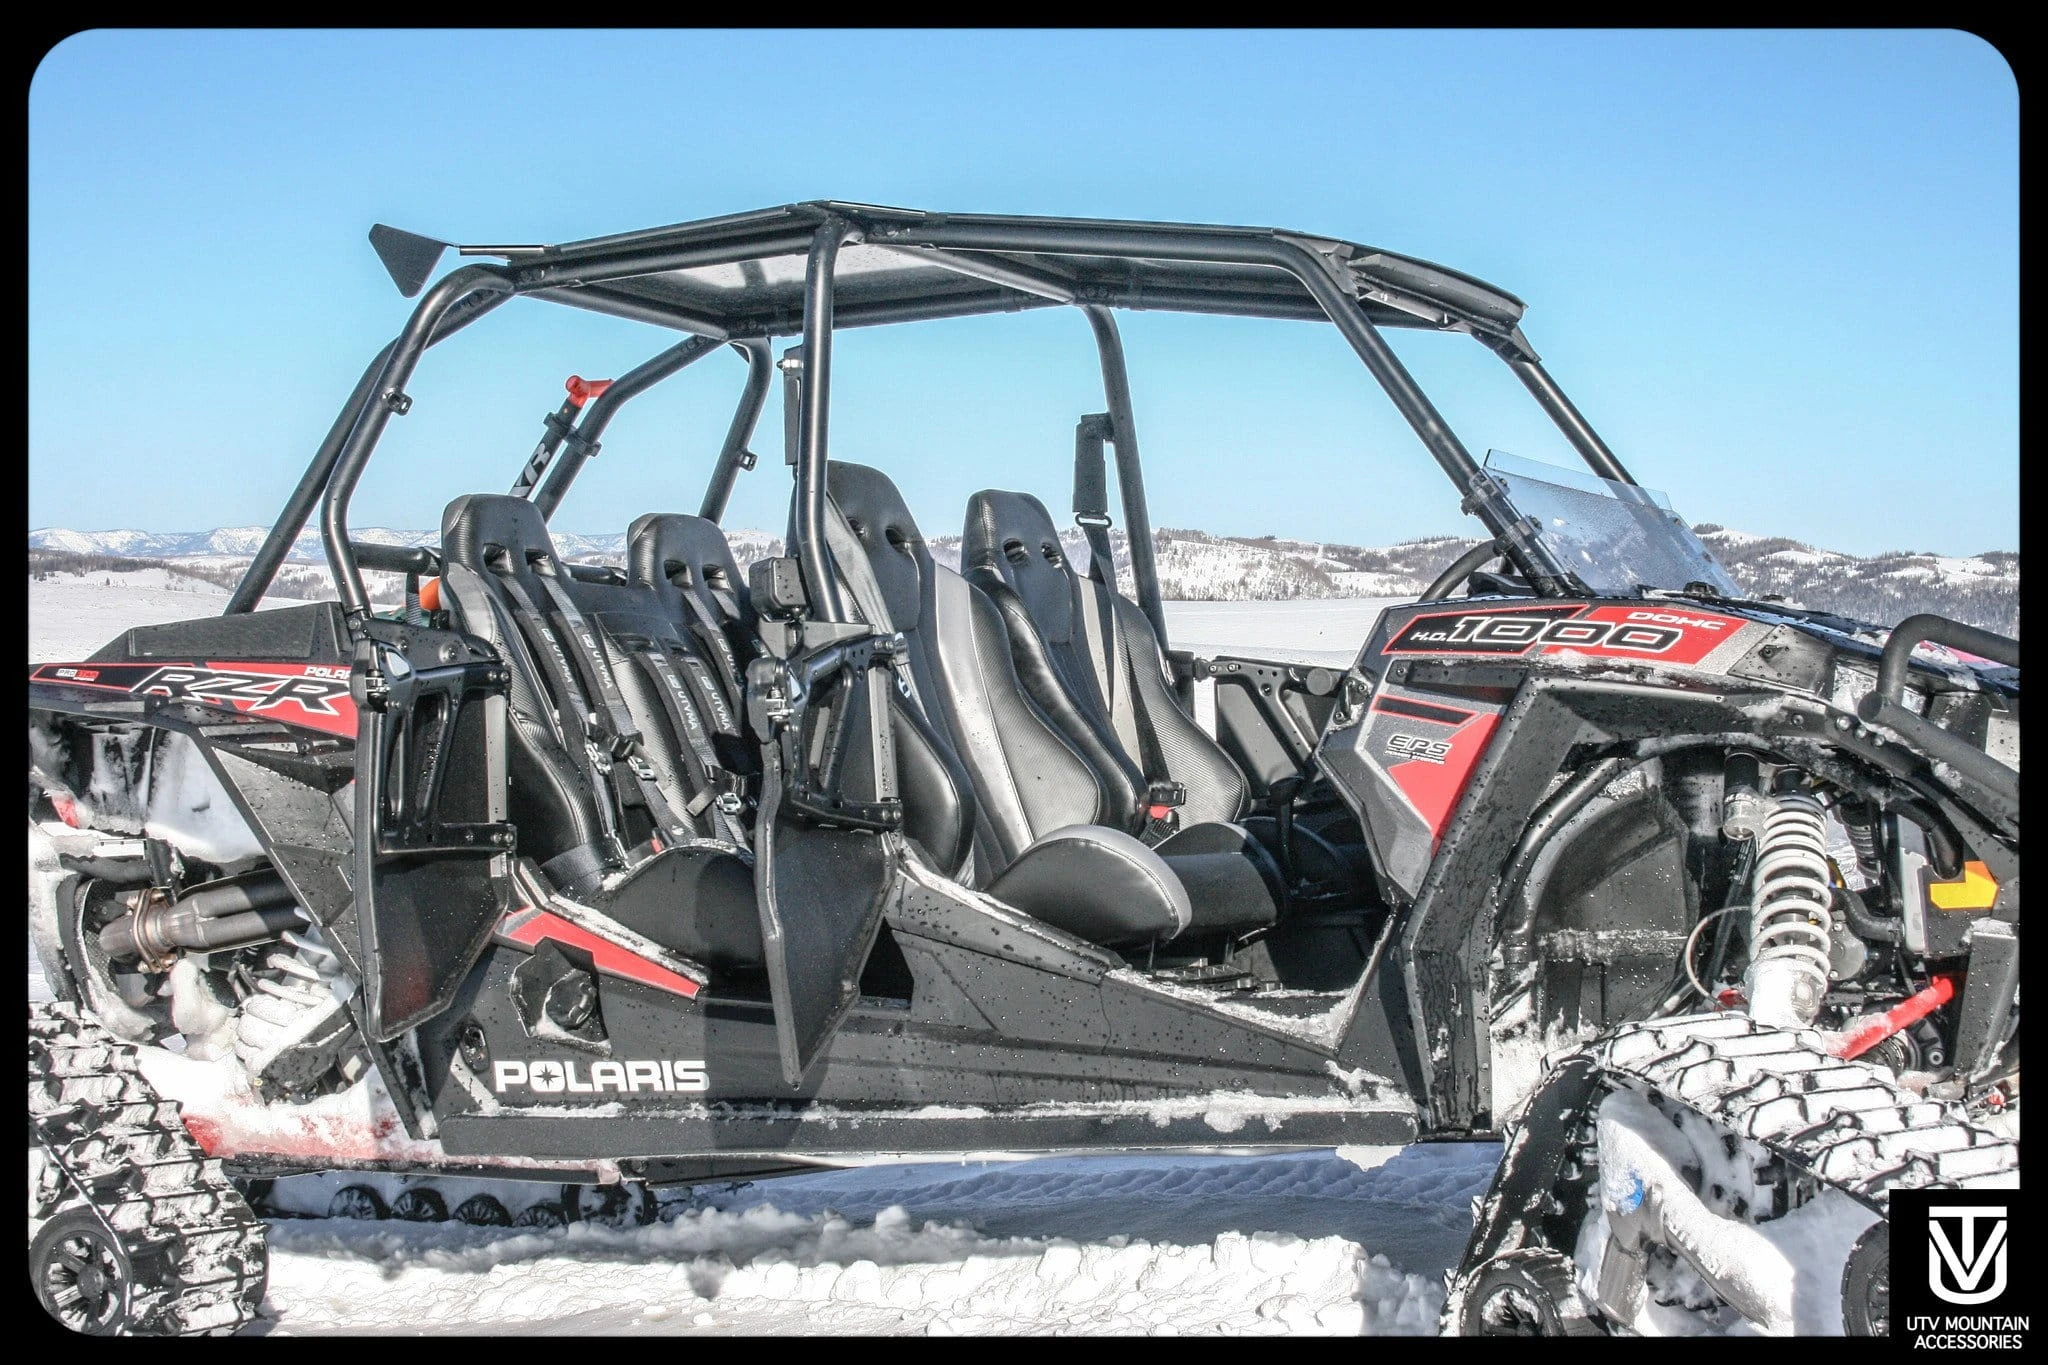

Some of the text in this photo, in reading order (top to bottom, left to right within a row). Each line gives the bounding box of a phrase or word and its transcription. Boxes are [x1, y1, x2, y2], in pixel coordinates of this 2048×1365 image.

[1410, 616, 1683, 653] H.O. 1000
[1626, 612, 1727, 631] DOHC
[553, 644, 572, 683] UTVMA
[592, 651, 613, 689] UTVMA
[129, 666, 350, 716] RZR
[677, 691, 698, 730] UTVMA
[711, 692, 731, 730] UTVMA
[1387, 733, 1453, 756] EPS
[493, 1060, 711, 1093] POLARIS
